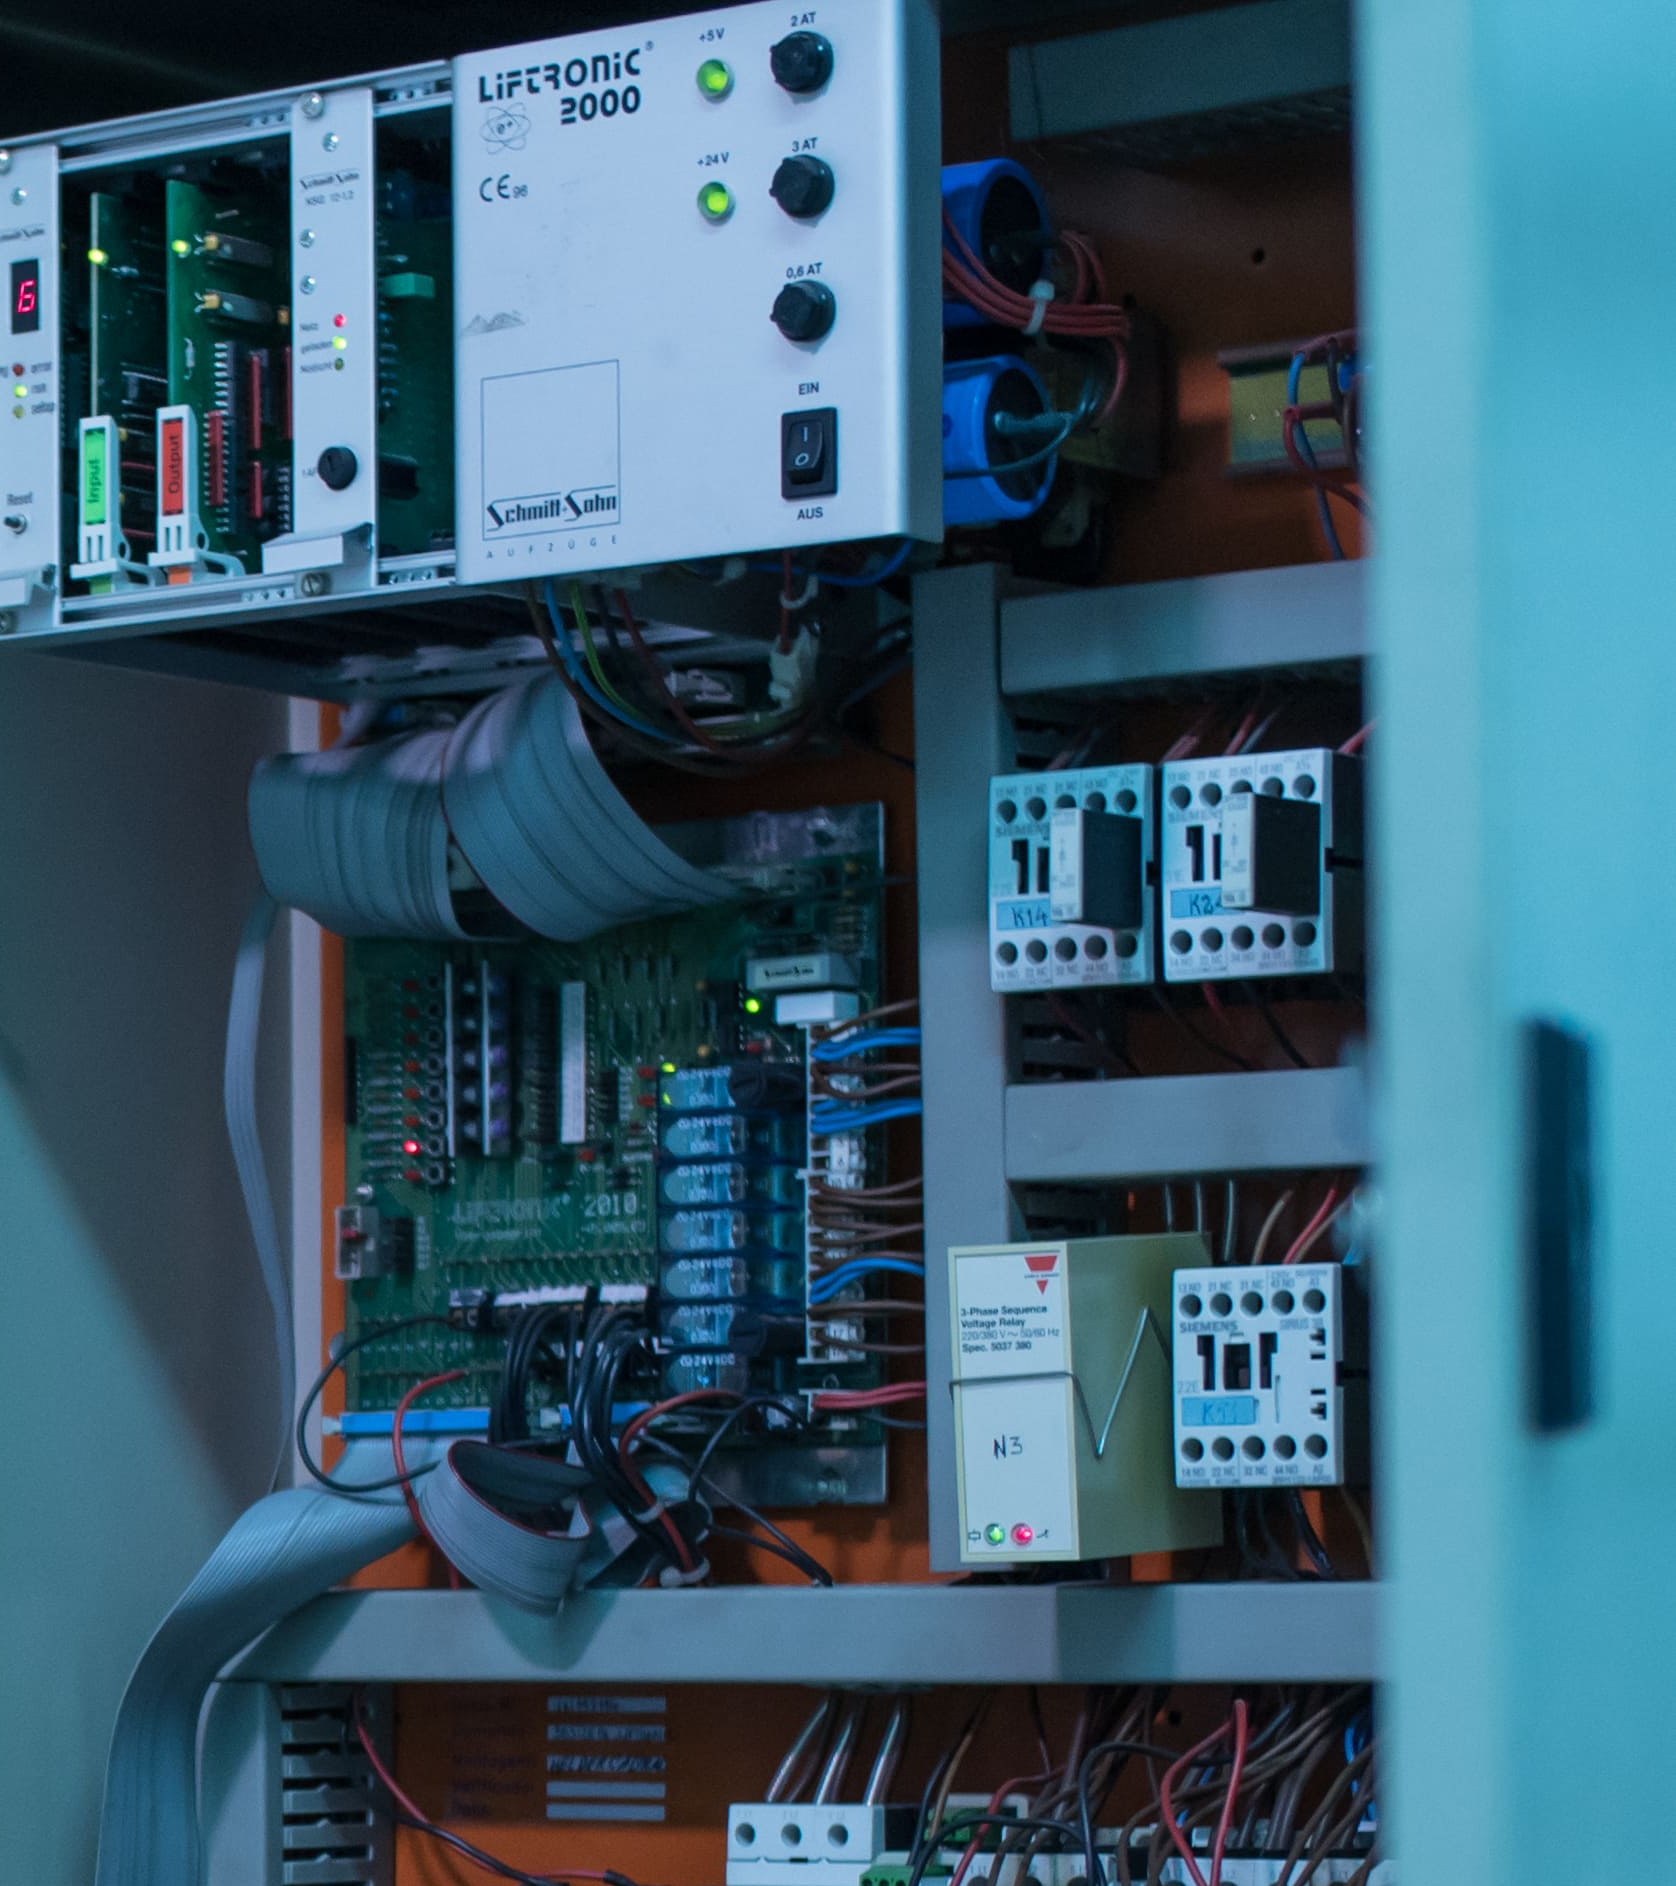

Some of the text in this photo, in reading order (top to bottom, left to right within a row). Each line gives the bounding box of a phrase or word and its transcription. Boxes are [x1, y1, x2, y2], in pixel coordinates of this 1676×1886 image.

[560, 85, 641, 125] 2000
[17, 280, 36, 313] 6
[799, 382, 819, 395] EIN
[168, 434, 180, 494] Output
[797, 507, 823, 520] AUS
[1001, 1305, 1048, 1316] Sequence
[960, 1317, 1026, 1329] Voltage Relay
[993, 1434, 1023, 1460] N3
